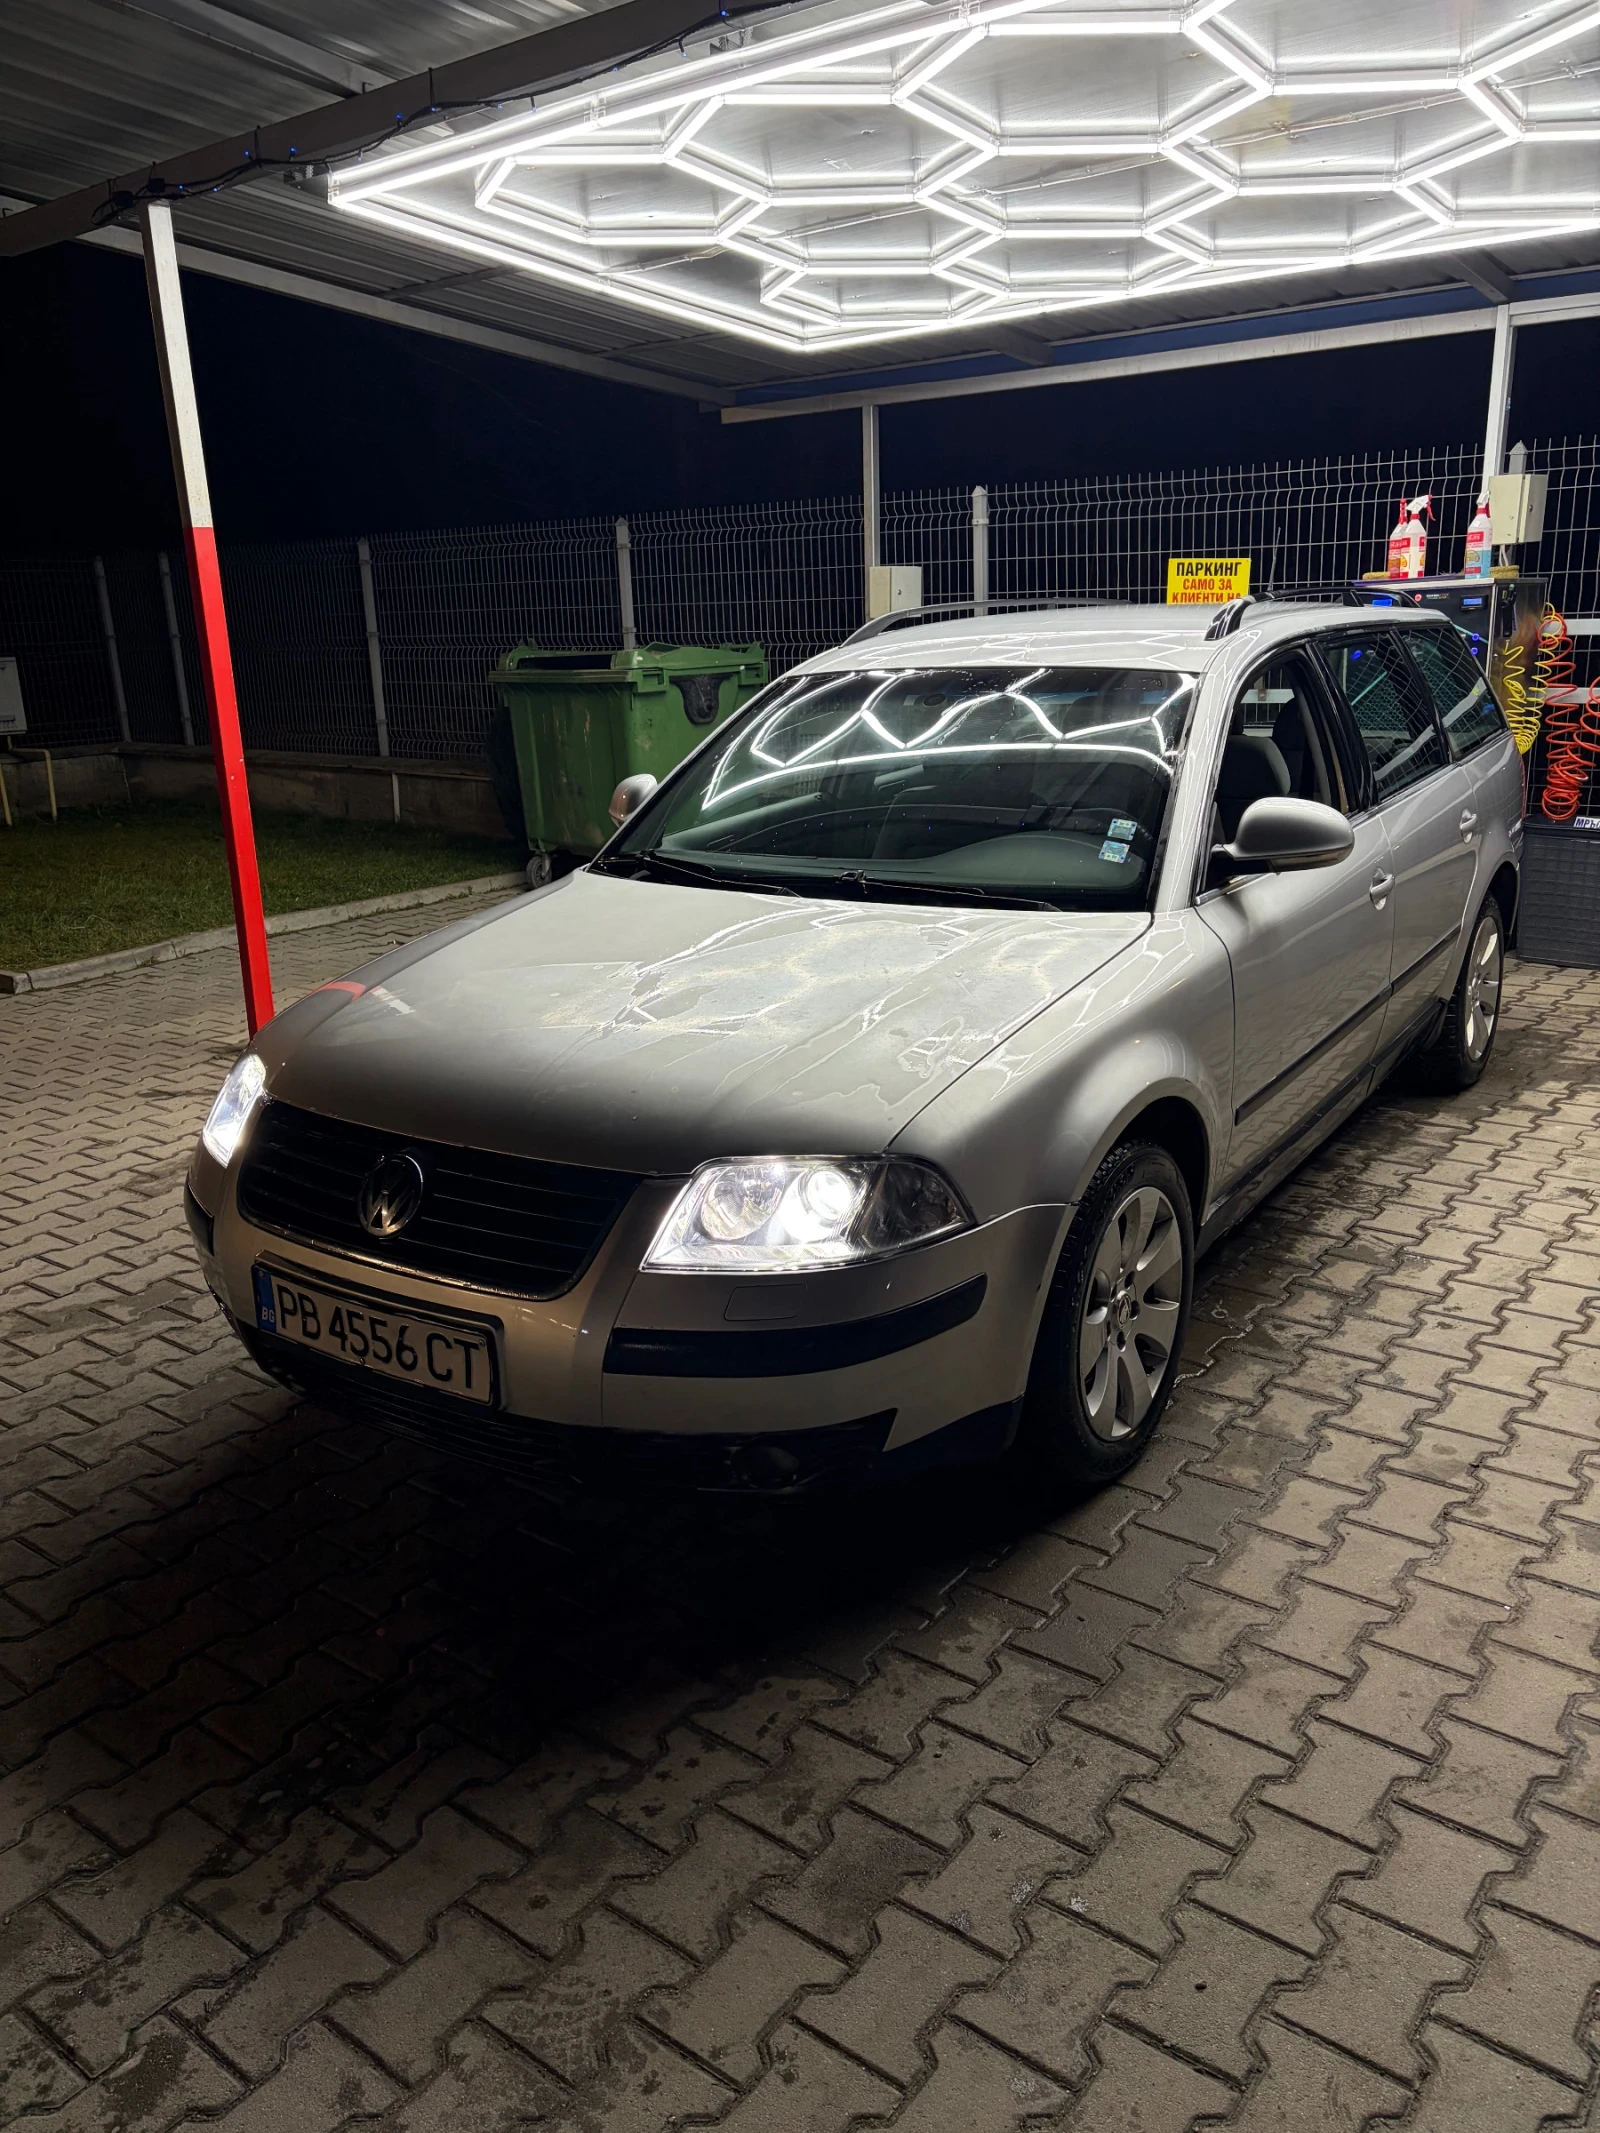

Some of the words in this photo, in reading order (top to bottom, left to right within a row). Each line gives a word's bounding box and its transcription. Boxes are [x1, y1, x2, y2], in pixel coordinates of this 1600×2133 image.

[1176, 562, 1242, 576] ПАРКИНГ
[1183, 579, 1215, 590] САМО
[1218, 579, 1232, 590] ЗА
[1172, 592, 1223, 603] КЛИЕНТИ
[261, 1306, 275, 1324] BG
[329, 1306, 418, 1371] 4556
